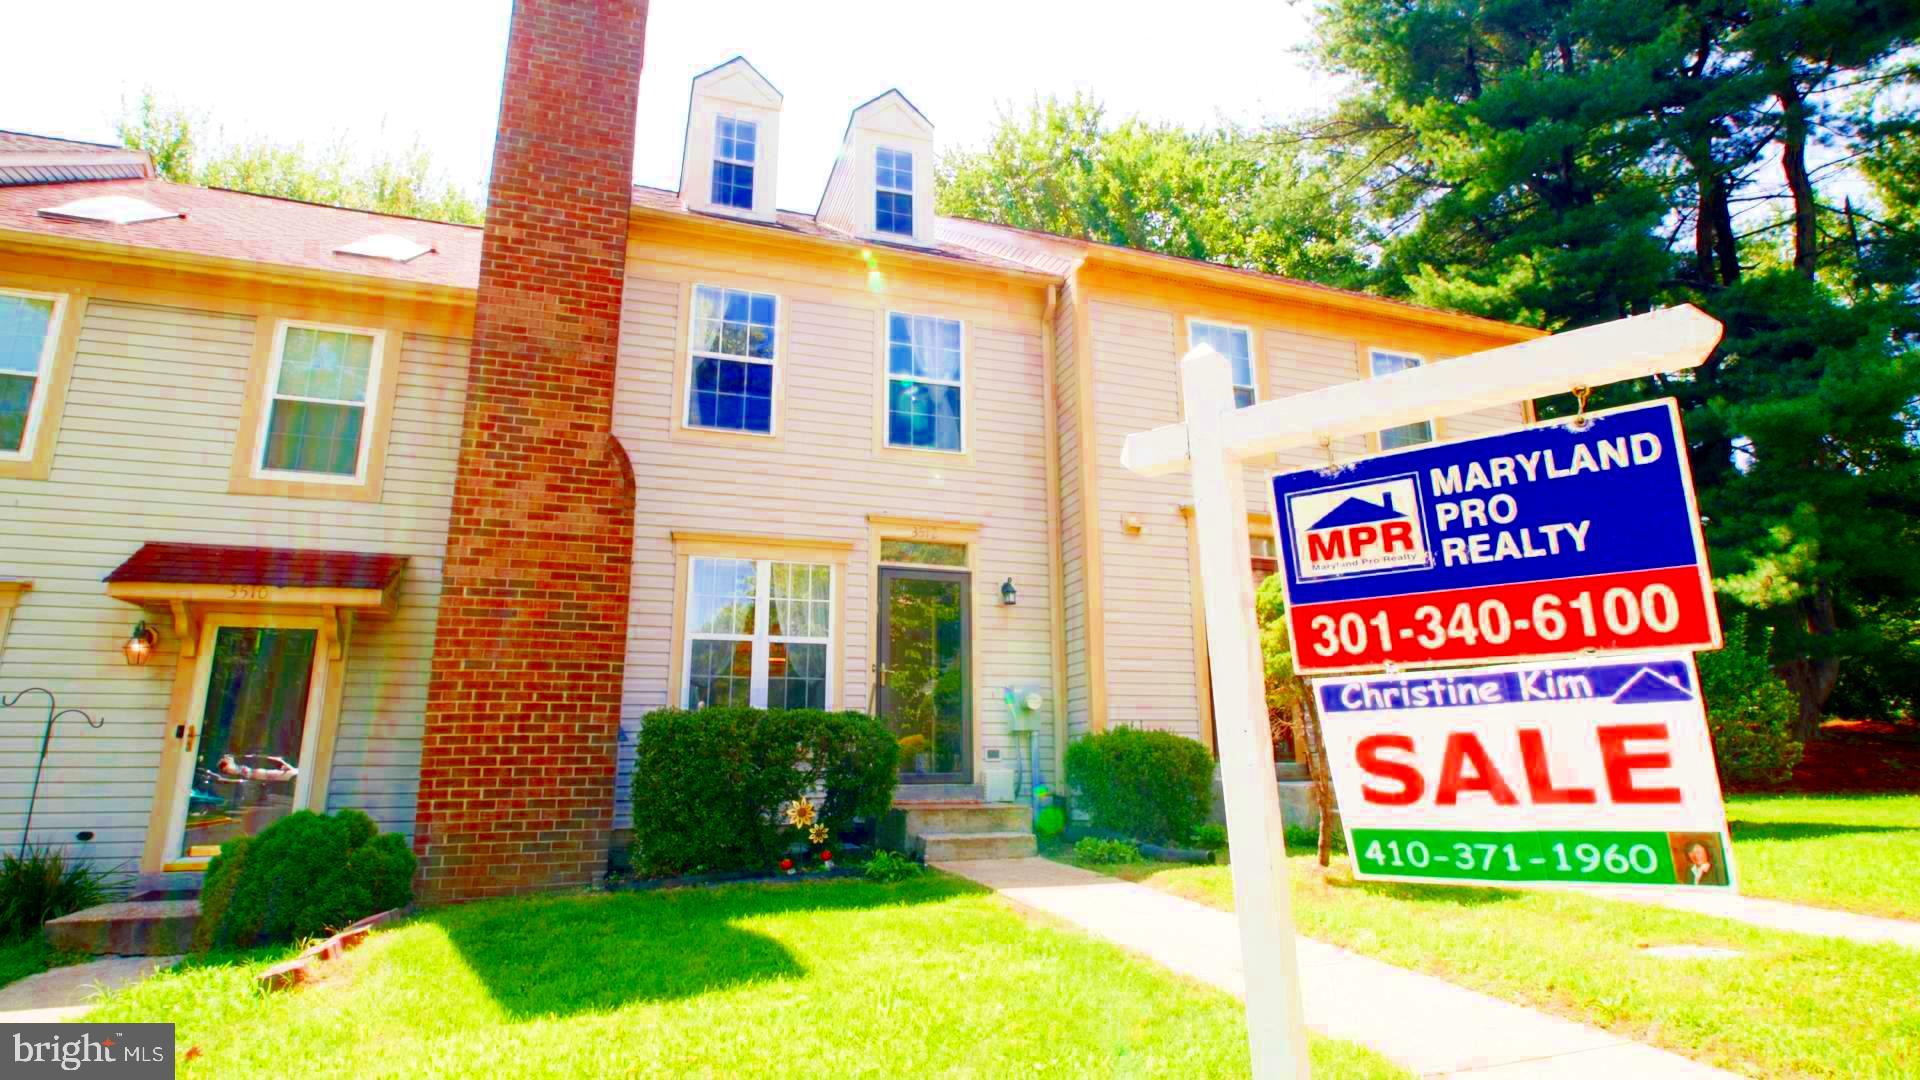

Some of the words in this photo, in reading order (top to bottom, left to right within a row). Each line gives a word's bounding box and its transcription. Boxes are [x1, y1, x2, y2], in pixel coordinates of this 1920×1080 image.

[1430, 432, 1662, 497] MARYLAND
[1436, 494, 1518, 531] PRO
[1307, 520, 1414, 563] MPR
[1312, 557, 1358, 571] Maryland
[1361, 557, 1380, 566] Pro
[1383, 552, 1417, 563] Realty
[1441, 520, 1591, 567] REALTY
[228, 585, 269, 599] 3510
[1311, 583, 1679, 657] 301-340-6100
[1340, 677, 1501, 710] Christine
[1518, 669, 1593, 701] Kim
[1355, 722, 1682, 806] SALE
[1364, 839, 1658, 874] 410-371-1960
